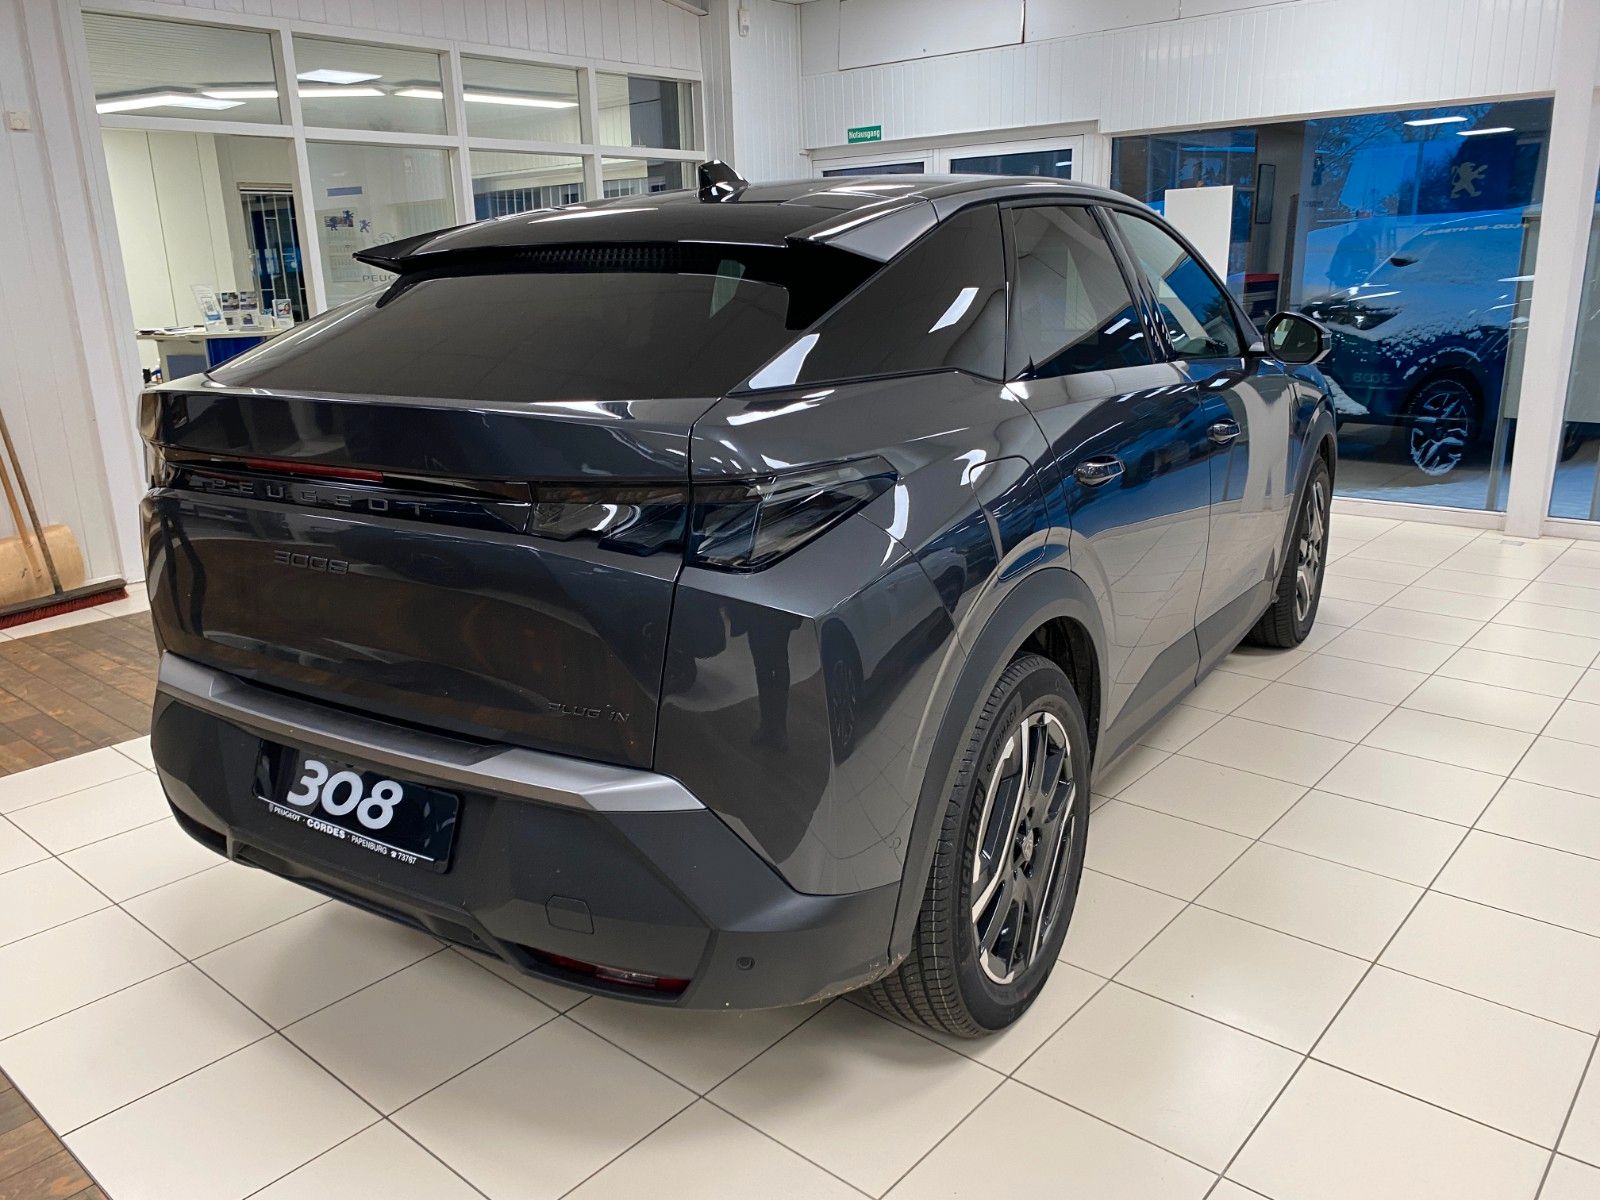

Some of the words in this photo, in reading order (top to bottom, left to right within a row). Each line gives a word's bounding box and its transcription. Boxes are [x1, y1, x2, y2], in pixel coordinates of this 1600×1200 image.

[848, 129, 881, 139] Notausgang
[362, 274, 397, 282] PEUG
[213, 480, 427, 516] PEUGEOT
[273, 549, 349, 575] 3008
[286, 759, 404, 830] 308
[274, 806, 301, 822] PEUGEOT
[306, 818, 346, 839] CORDES
[351, 835, 388, 855] PAPENBURG
